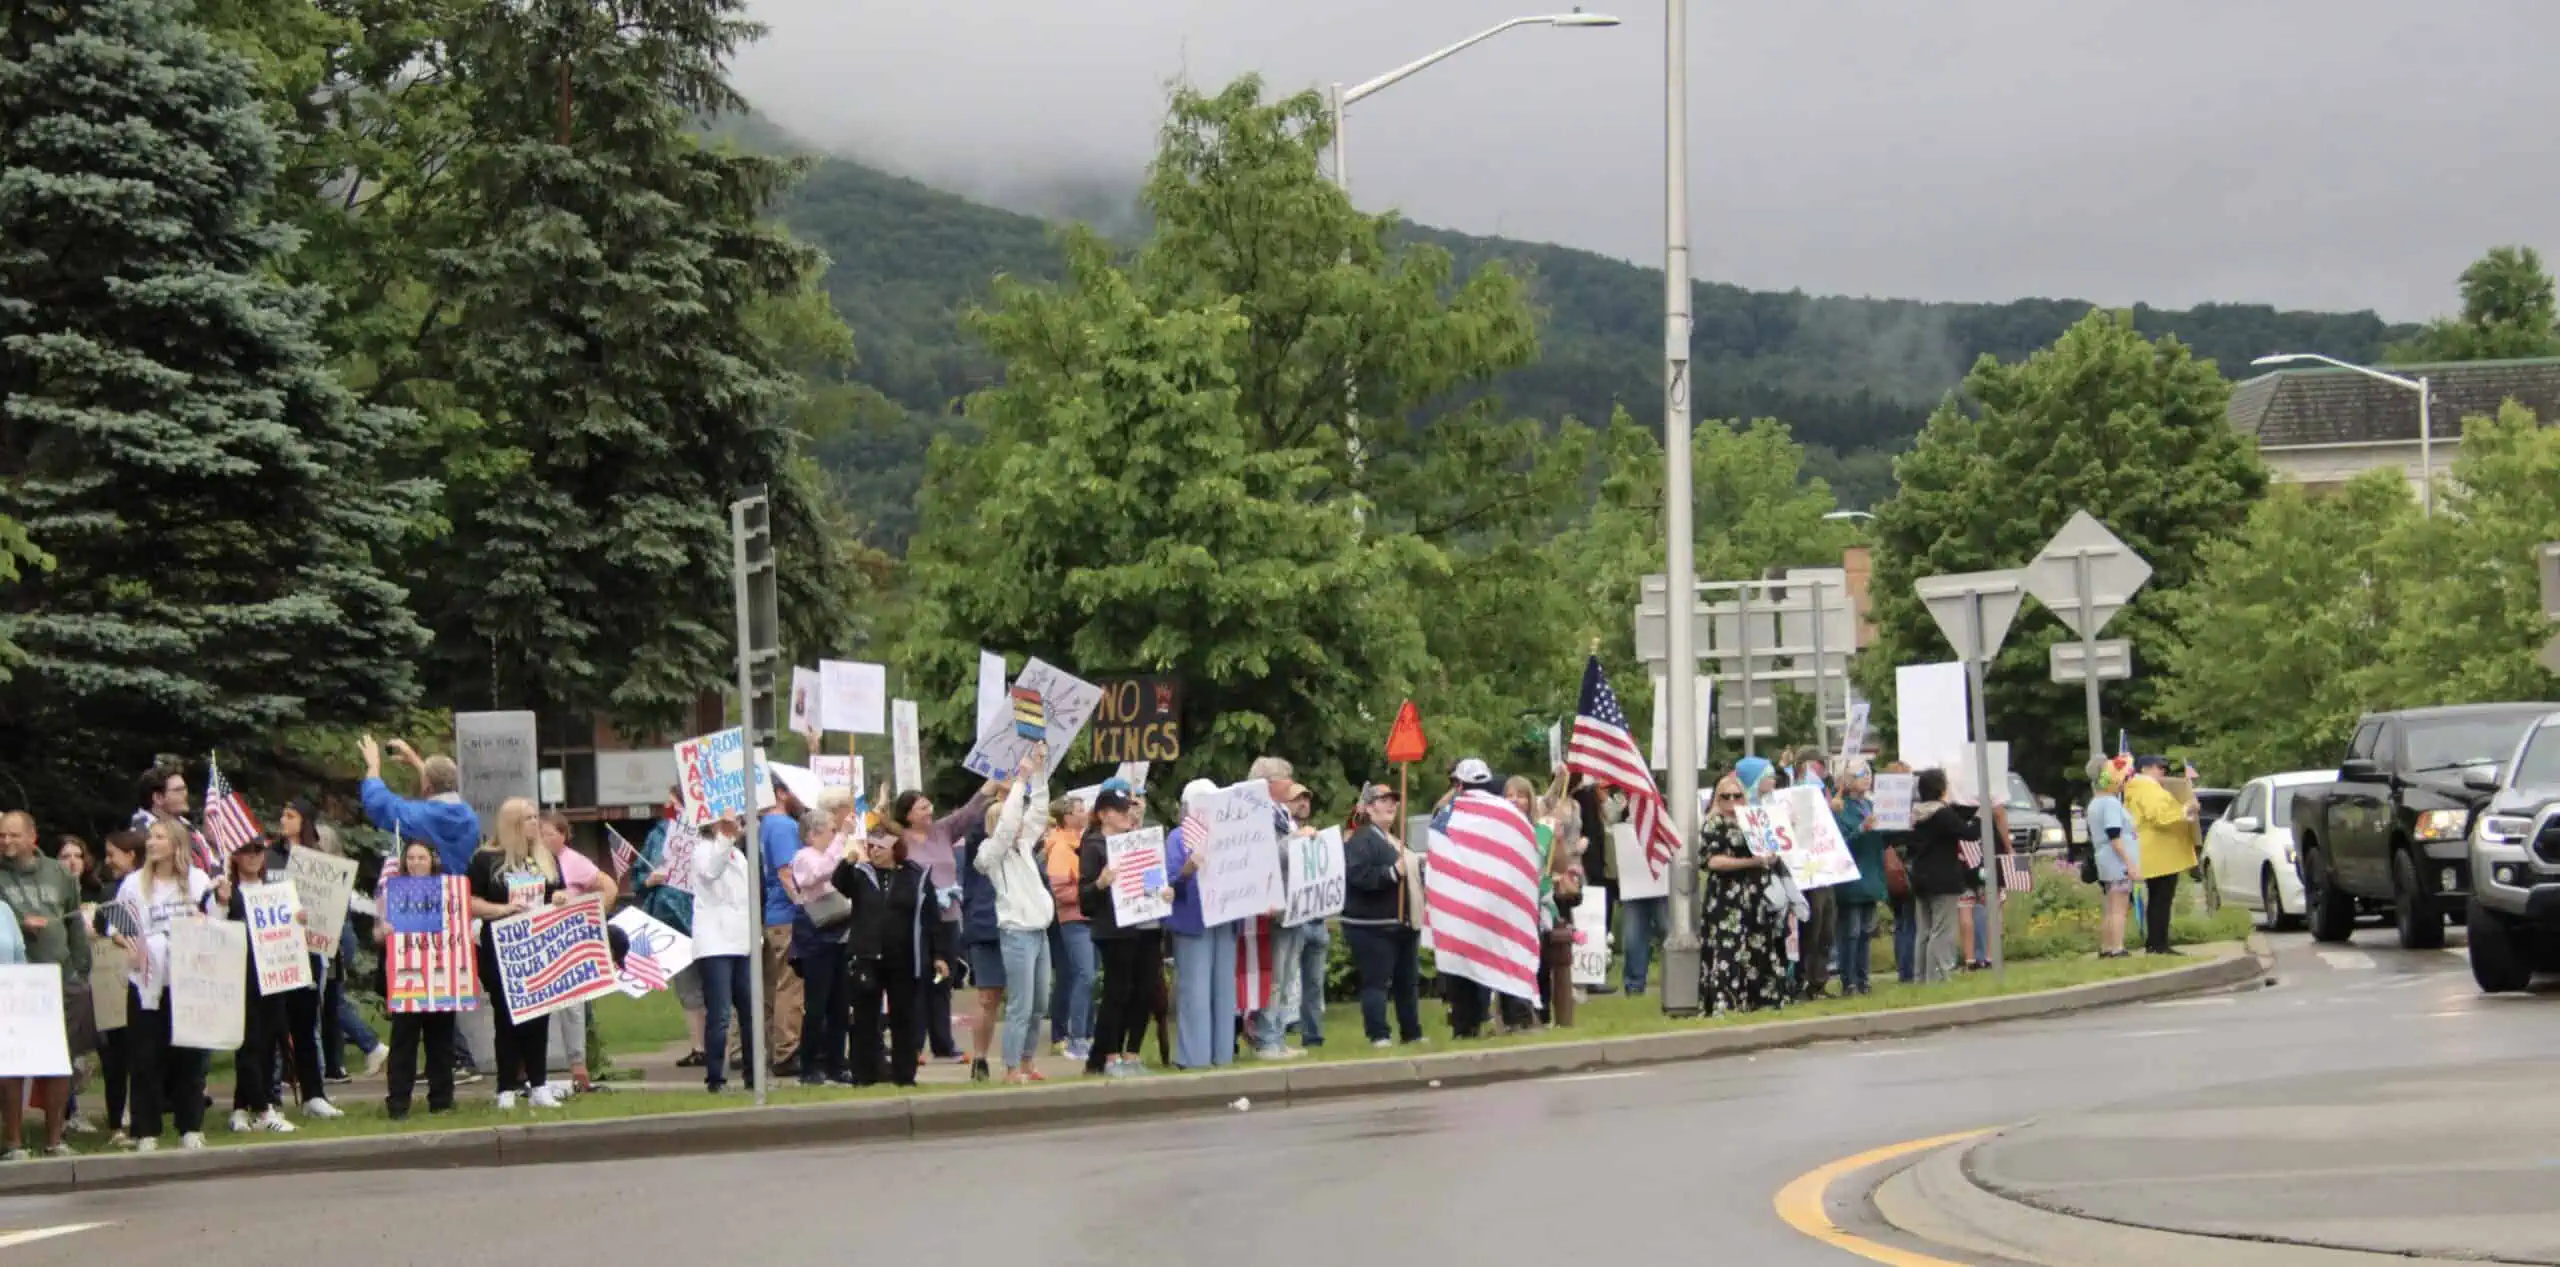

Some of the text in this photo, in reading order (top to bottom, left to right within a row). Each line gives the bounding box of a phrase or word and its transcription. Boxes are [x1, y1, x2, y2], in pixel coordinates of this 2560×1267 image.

[1098, 680, 1140, 722] NO
[1093, 721, 1179, 763] KINGS
[1745, 808, 1771, 829] NO
[1302, 837, 1329, 882] NO
[253, 903, 293, 930] BIG
[1290, 874, 1342, 920] KINGS
[497, 918, 531, 943] STOP
[501, 913, 585, 961] PRETENDING
[505, 926, 604, 978] YOUR RACISM
[508, 978, 525, 994] IS
[510, 960, 600, 1009] PATRIOTISM
